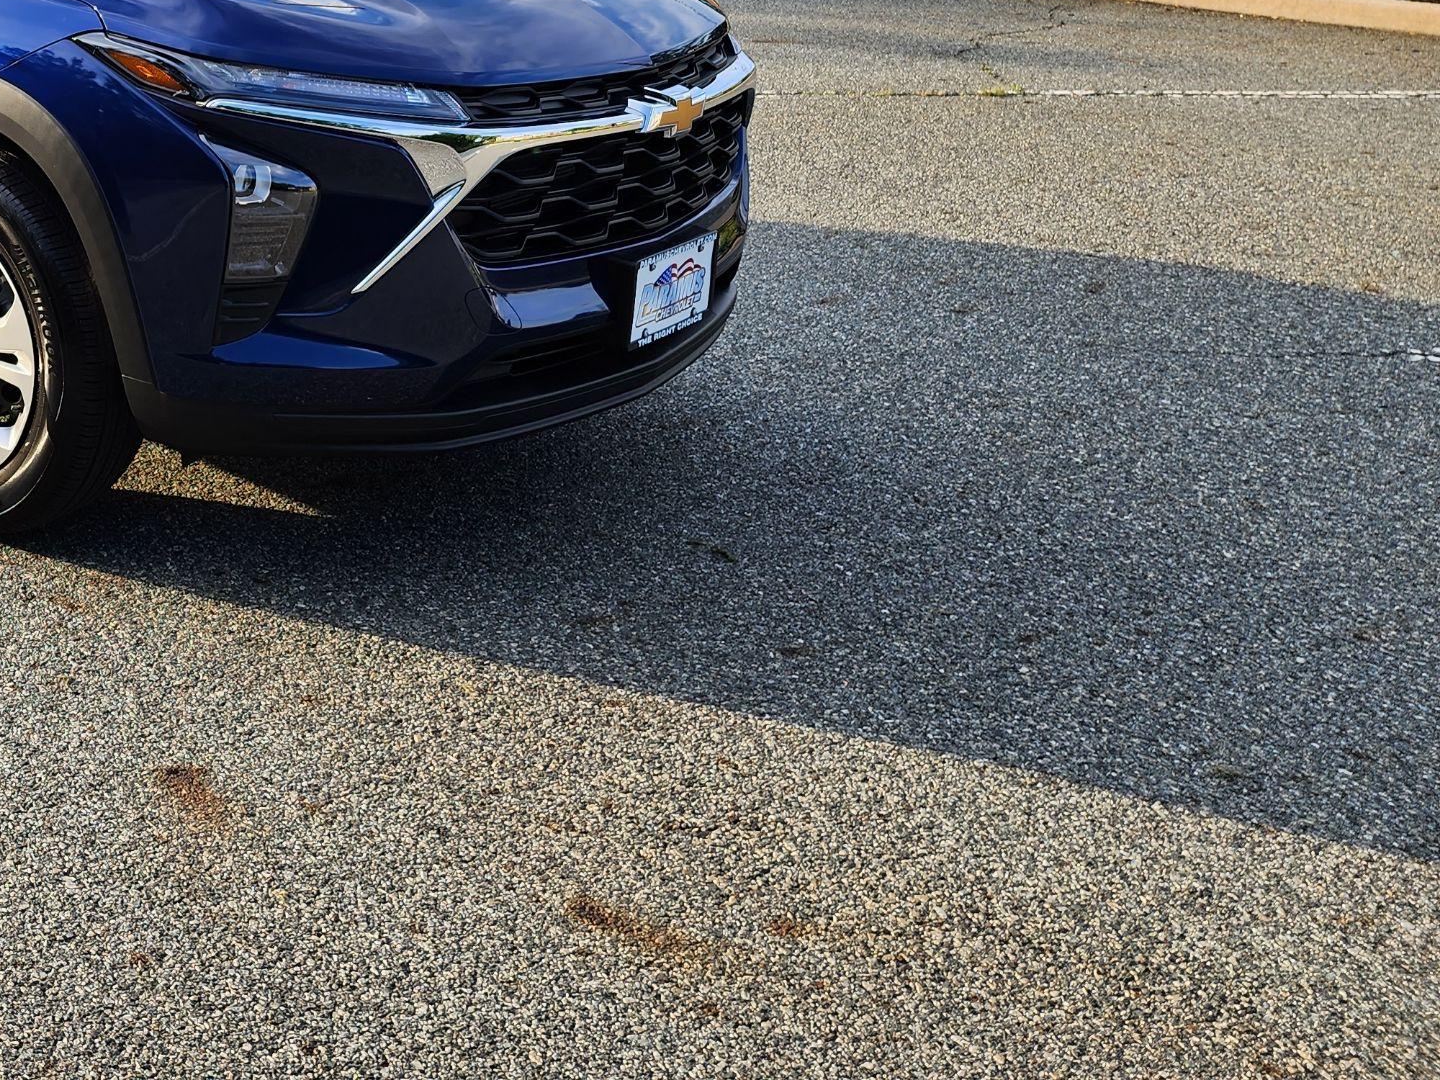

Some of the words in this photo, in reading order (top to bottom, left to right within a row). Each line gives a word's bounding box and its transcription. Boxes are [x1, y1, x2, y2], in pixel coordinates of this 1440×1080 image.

[640, 267, 705, 318] PARAMUS
[655, 297, 694, 322] CHEVROLET
[638, 335, 652, 347] THE
[654, 326, 677, 341] RIGHT
[677, 313, 703, 330] CHOICE
